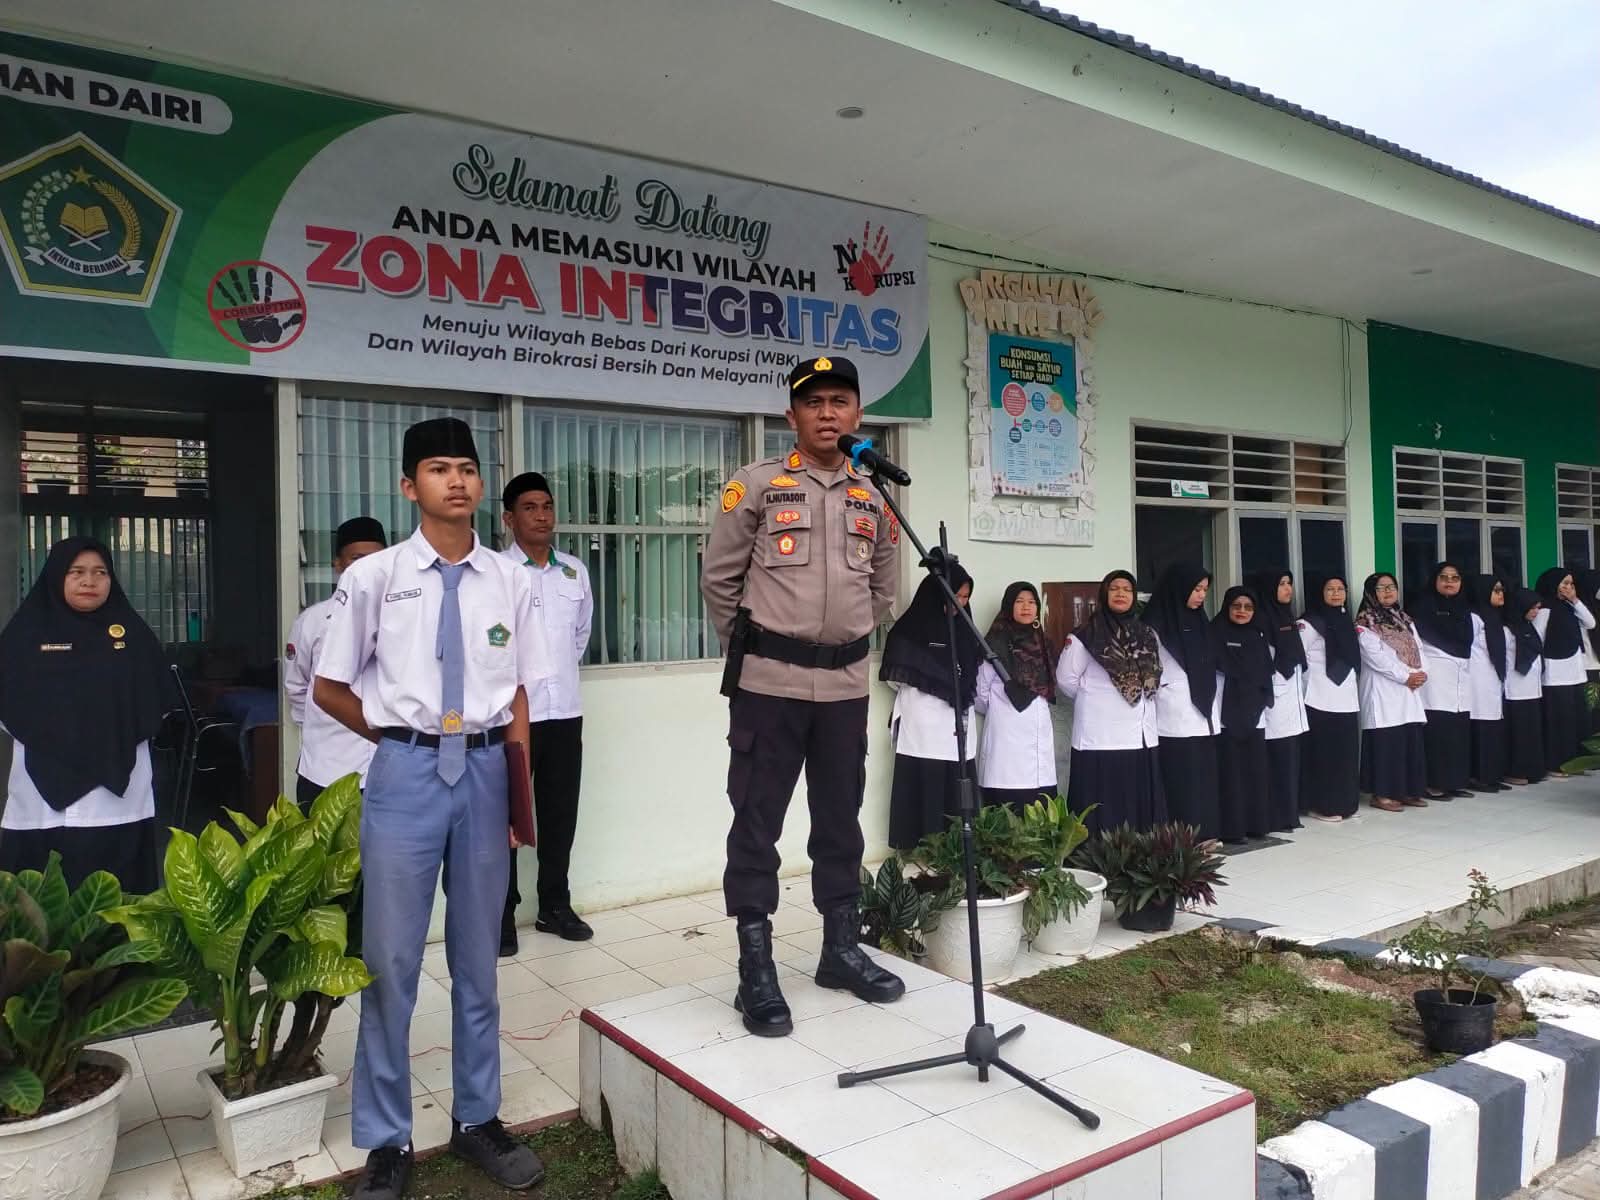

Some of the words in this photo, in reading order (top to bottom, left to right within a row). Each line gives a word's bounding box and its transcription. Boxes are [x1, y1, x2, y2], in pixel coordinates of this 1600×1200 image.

[0, 64, 74, 100] AN
[89, 80, 202, 124] DAIRI
[452, 144, 619, 220] Selamat
[634, 179, 771, 258] Datang
[48, 249, 82, 272] IKHLAS
[82, 256, 125, 274] BERAMAL
[392, 206, 501, 245] ANDA
[511, 223, 683, 273] MEMASUKI
[693, 252, 816, 292] WILAYAH
[305, 225, 543, 312] ZONA
[559, 262, 901, 354] INTEGRITAS
[368, 333, 413, 353] Dan
[421, 338, 507, 361] Wilayah
[514, 346, 597, 370] Birokrasi
[602, 356, 657, 375] Bersih
[662, 362, 696, 379] Dan
[701, 367, 773, 386] Melayani
[423, 313, 500, 338] Menuju
[507, 324, 585, 346] Wilayah
[592, 333, 646, 351] Bebas
[651, 339, 685, 357] Dari
[690, 343, 750, 367] Korupsi
[1000, 357, 1023, 369] BUAH
[1037, 362, 1061, 375] SAYUR
[1010, 348, 1051, 363] KONSUMSI
[1011, 370, 1035, 381] SETIAP
[1036, 373, 1053, 384] HARI
